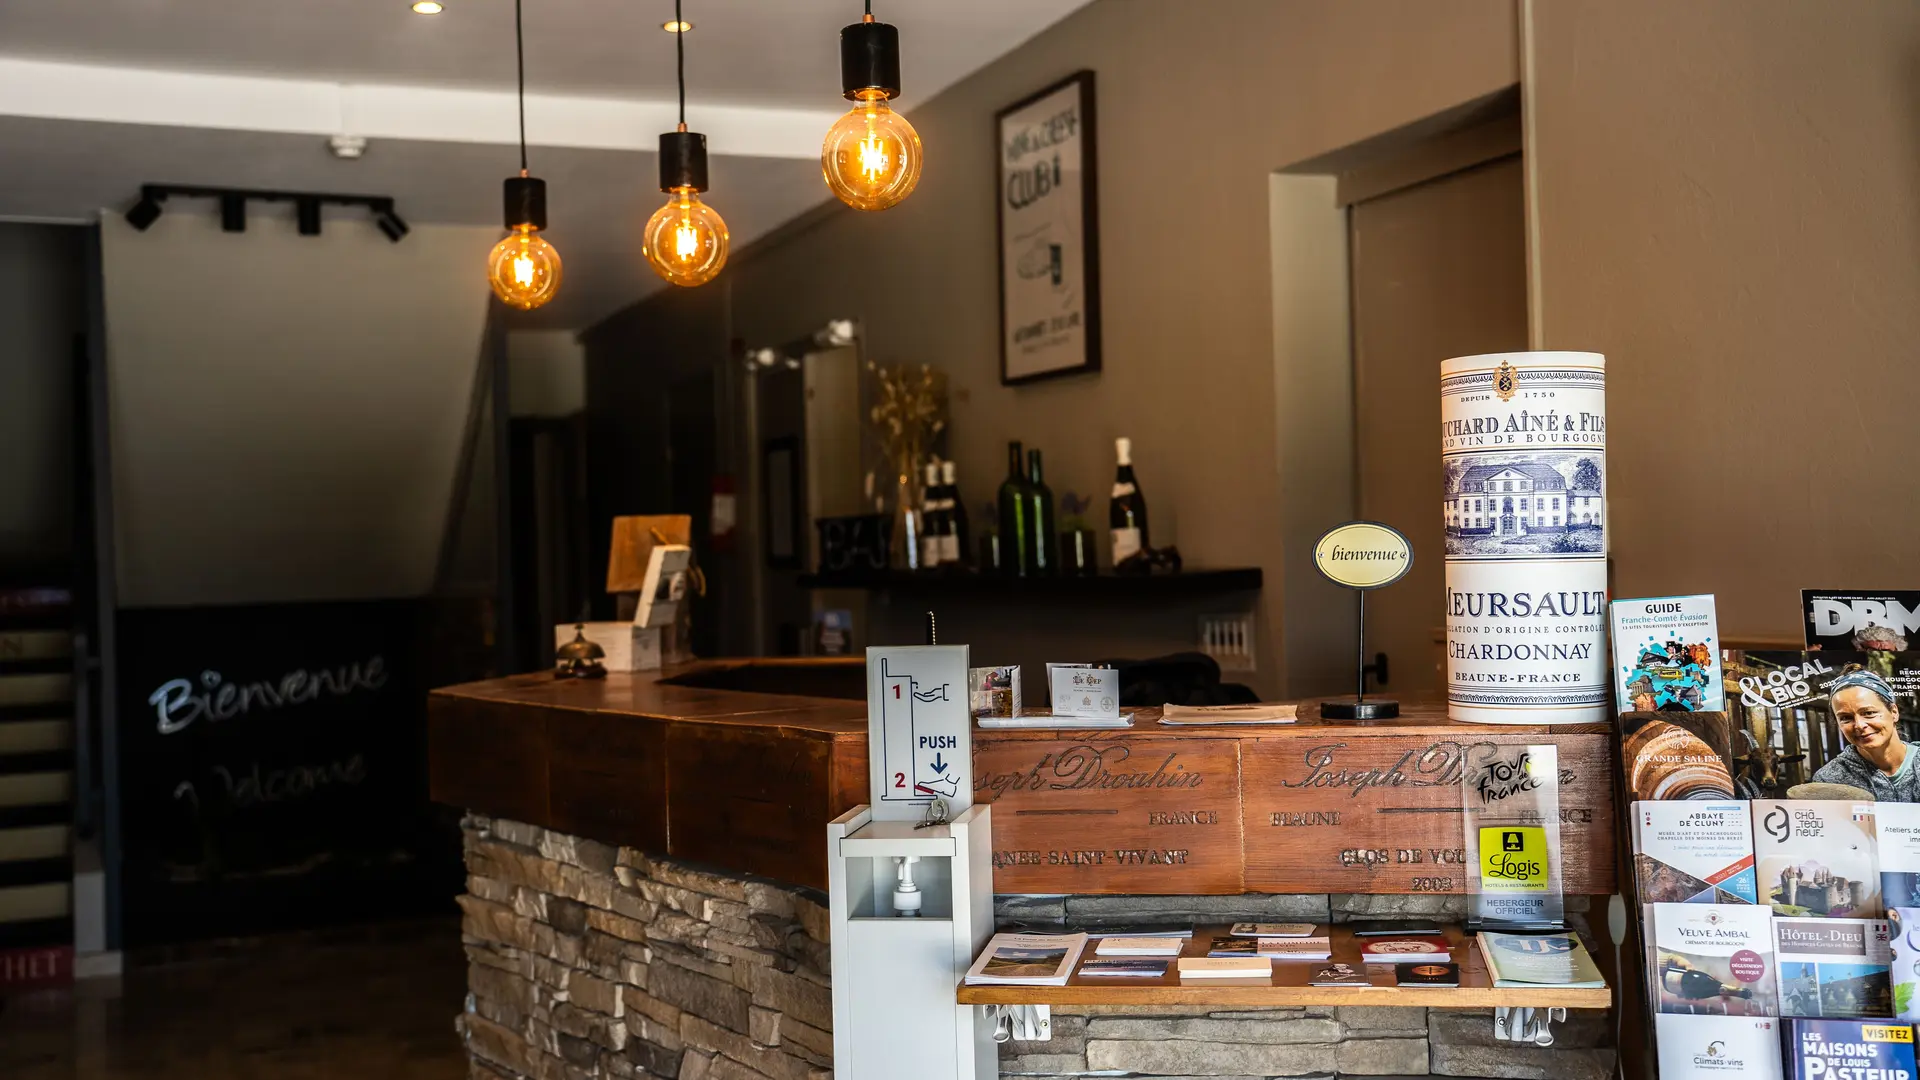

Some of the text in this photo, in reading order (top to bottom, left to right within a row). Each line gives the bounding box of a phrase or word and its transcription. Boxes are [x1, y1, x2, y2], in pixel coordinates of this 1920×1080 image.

[1460, 395, 1490, 403] DEPUIS
[1504, 409, 1558, 433] AÎNÉ
[1564, 417, 1575, 432] &
[1443, 438, 1455, 448] ND
[1460, 435, 1484, 446] VIN
[1494, 435, 1515, 444] DE
[1331, 544, 1398, 561] bienvenue
[1645, 602, 1682, 614] GUIDE
[1621, 612, 1708, 625] Franche-Comté Évasion
[1484, 625, 1550, 634] D'ORIGINE
[1449, 640, 1593, 661] CHARDONNAY
[1755, 658, 1833, 691] LOCAL
[146, 652, 390, 735] Bienvenue
[892, 684, 901, 699] 1
[1770, 680, 1811, 703] BIO
[919, 735, 957, 749] PUSH
[1636, 754, 1722, 763] GRANDE SALINE
[1281, 742, 1407, 799] Joseph
[1518, 771, 1528, 780] de
[894, 772, 906, 788] 2
[1148, 810, 1219, 825] FRANCE
[1270, 811, 1342, 826] BEAUNE
[1689, 812, 1725, 820] ABBAYE
[1884, 826, 1911, 834] Ateliers
[1341, 849, 1389, 867] CLOS
[1396, 849, 1424, 864] DE
[1488, 852, 1541, 881] Logis
[1495, 907, 1536, 916] OFFICIEL
[1677, 927, 1751, 939] VEUVE AMBAL
[0, 949, 62, 982] HET
[1802, 1032, 1822, 1041] LES
[1866, 1029, 1908, 1039] VISITEZ
[1803, 1041, 1878, 1057] MAISONS
[1693, 1056, 1743, 1066] Climats vins
[1827, 1057, 1871, 1067] DE LOUIS
